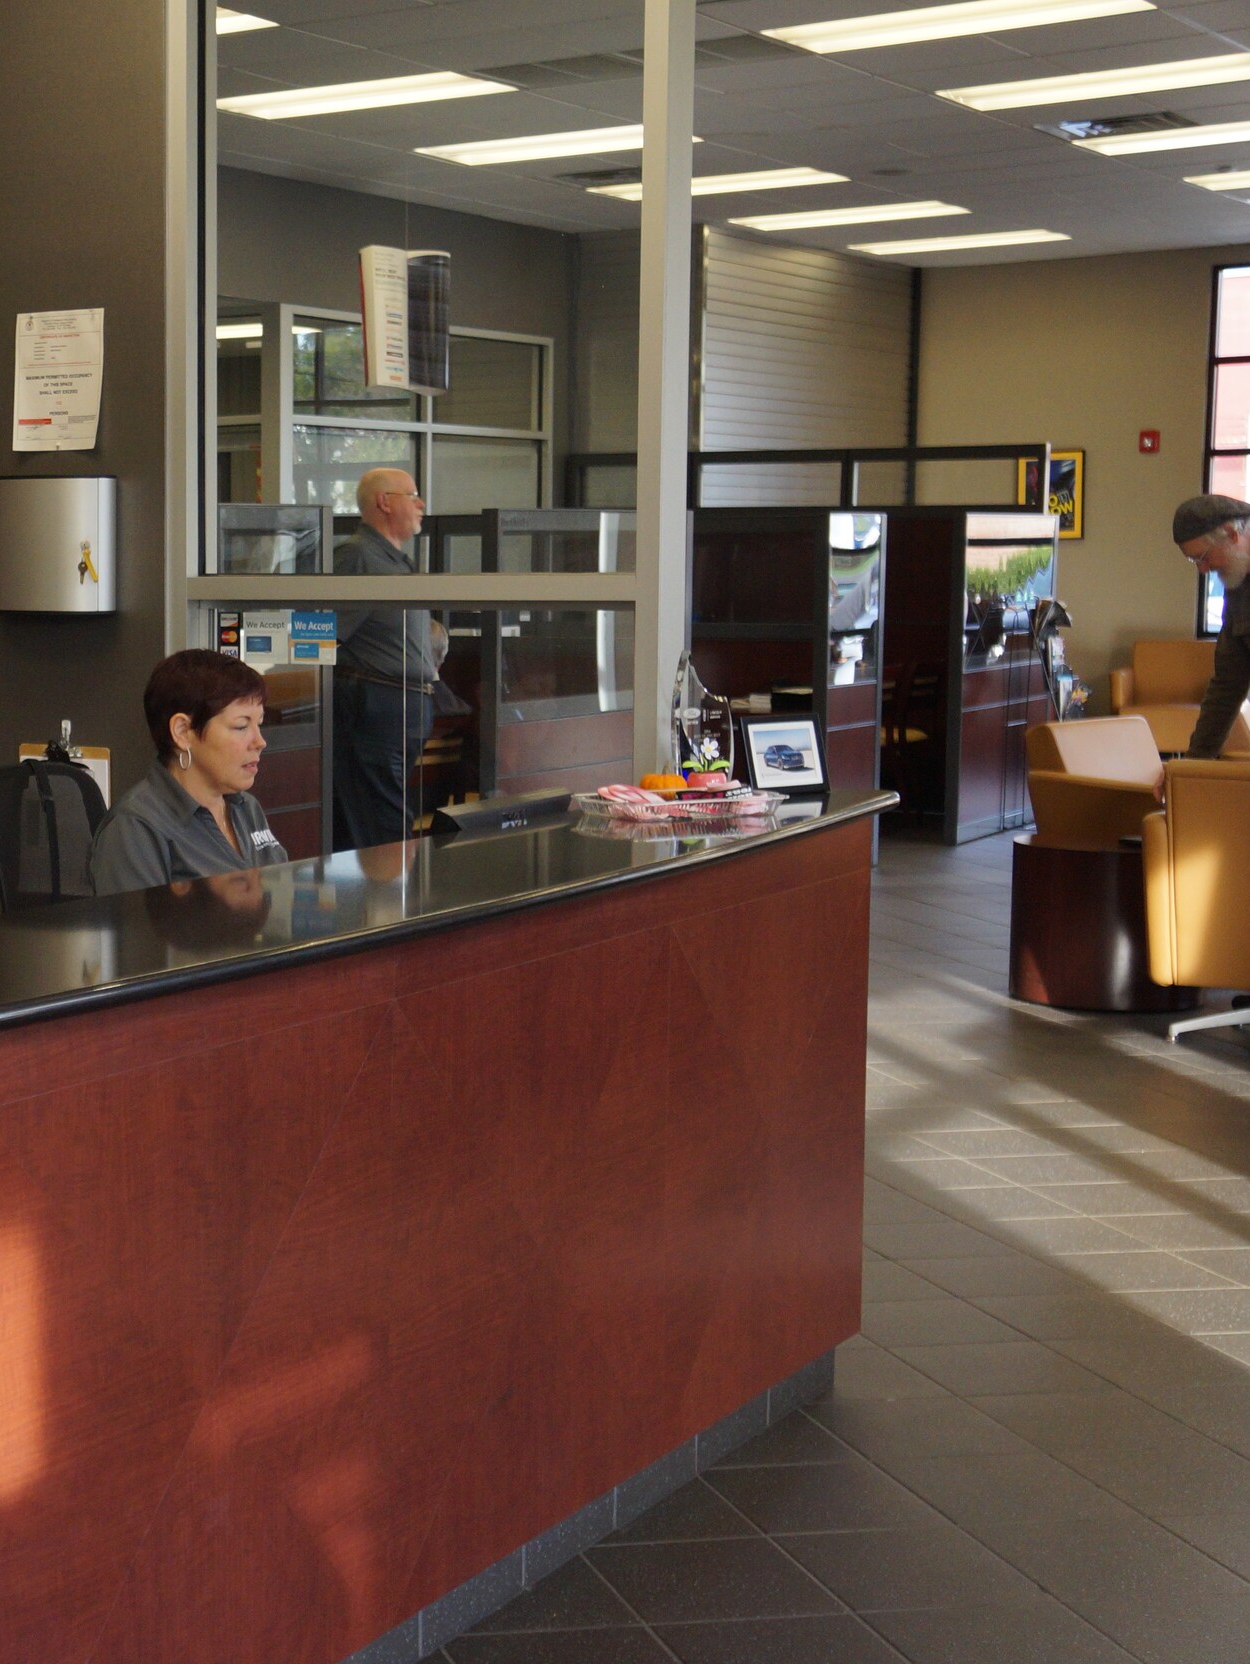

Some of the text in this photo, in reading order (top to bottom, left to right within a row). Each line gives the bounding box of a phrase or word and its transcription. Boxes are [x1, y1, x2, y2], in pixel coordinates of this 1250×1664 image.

[260, 621, 285, 630] Accept
[294, 621, 333, 632] We Accept
